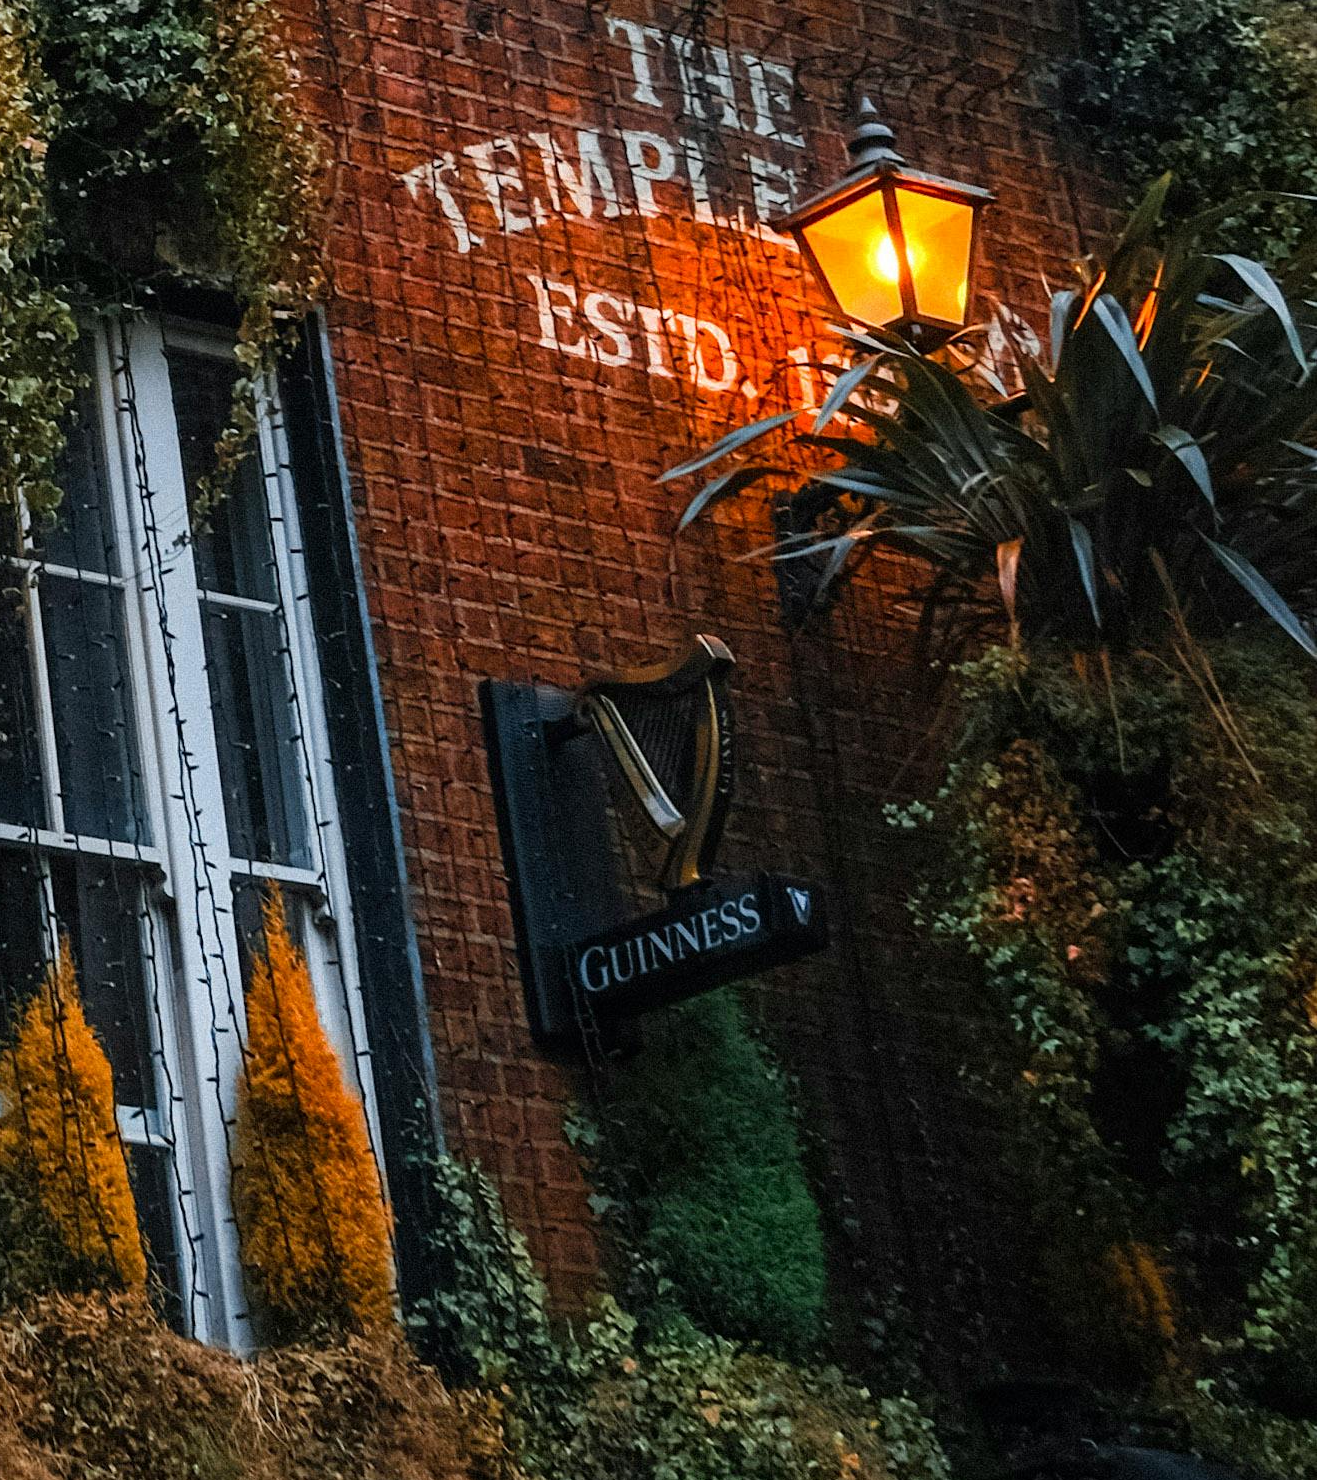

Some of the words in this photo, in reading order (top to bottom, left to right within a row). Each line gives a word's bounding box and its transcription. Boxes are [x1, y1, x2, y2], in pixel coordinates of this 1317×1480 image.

[607, 17, 806, 148] THE
[402, 128, 801, 254] TEMPLE
[579, 893, 763, 994] GUINNESS
